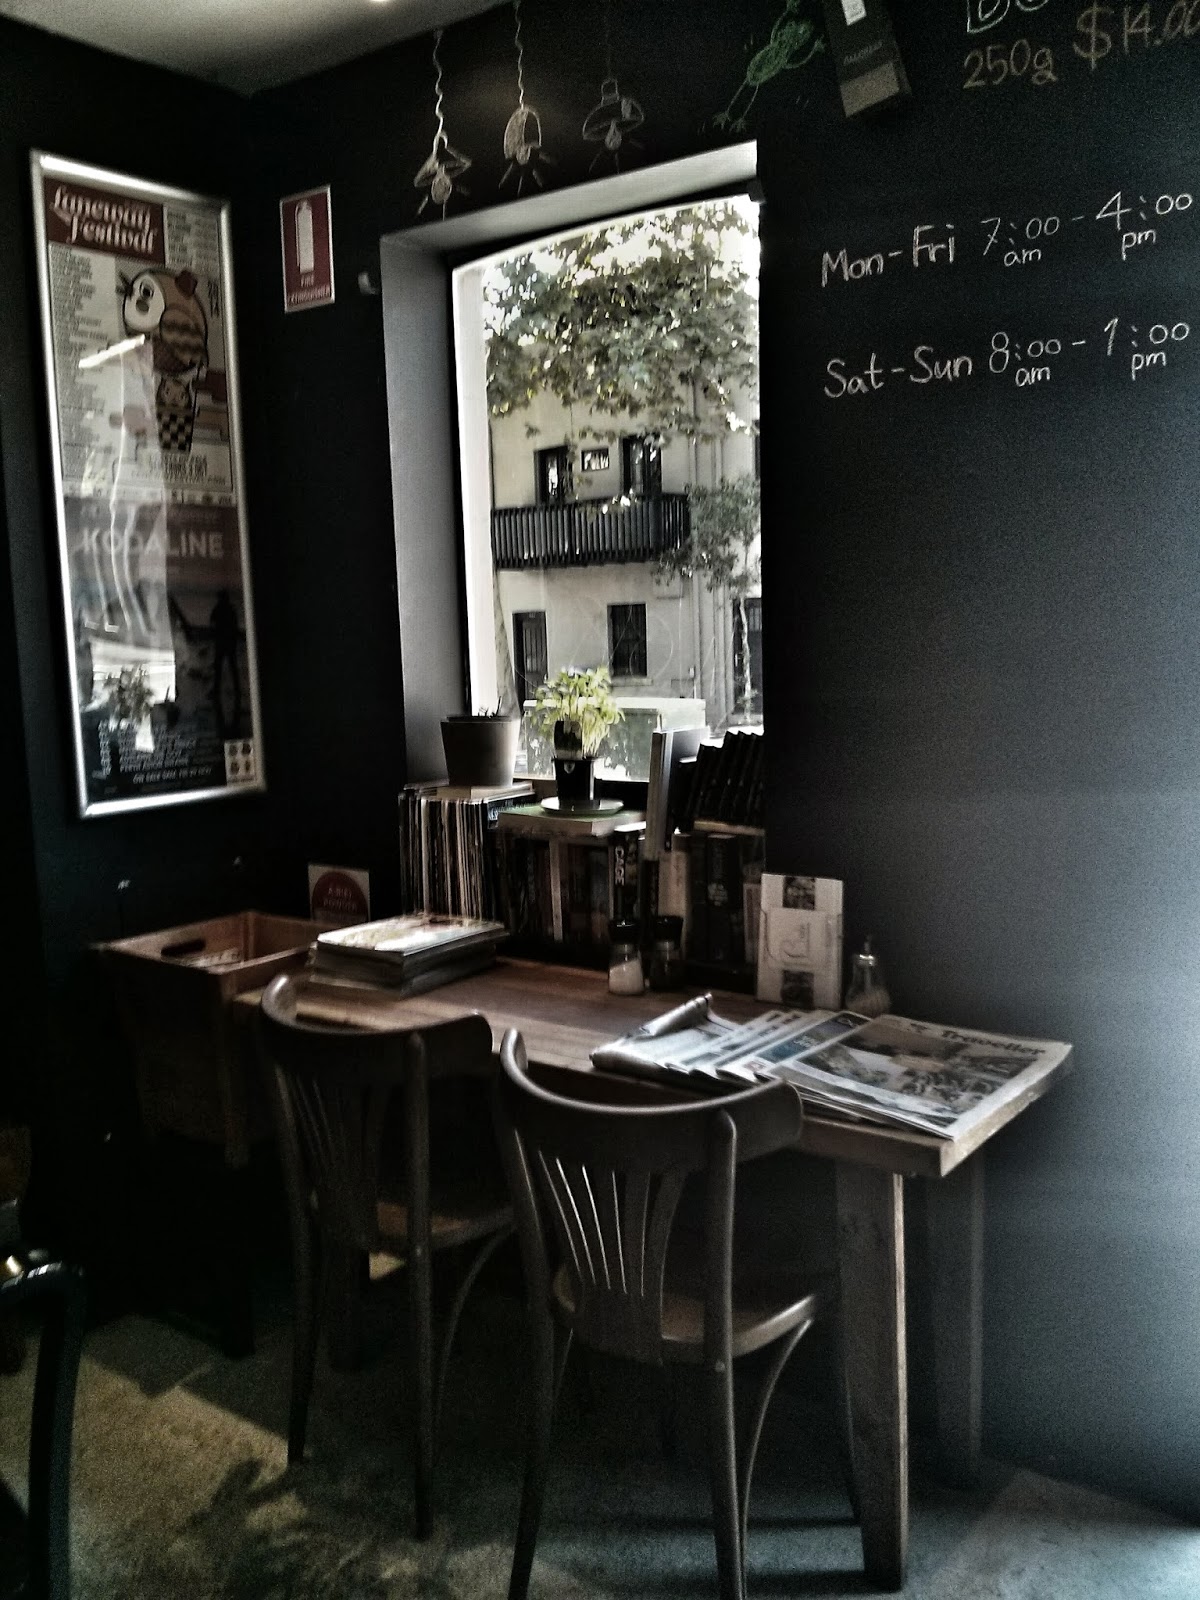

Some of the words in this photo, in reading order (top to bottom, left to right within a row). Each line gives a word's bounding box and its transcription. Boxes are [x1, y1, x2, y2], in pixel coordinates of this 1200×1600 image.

[963, 38, 1058, 88] 250g
[821, 224, 955, 287] Mon-Fri
[980, 217, 1060, 256] 7:00
[1095, 191, 1193, 231] 4:00
[1122, 228, 1157, 261] pm
[1004, 246, 1042, 267] am
[824, 346, 973, 399] Sat-Sun
[989, 331, 1062, 374] 8:00
[1104, 318, 1190, 356] 1:00
[1132, 351, 1167, 381] pm
[1015, 366, 1051, 387] am
